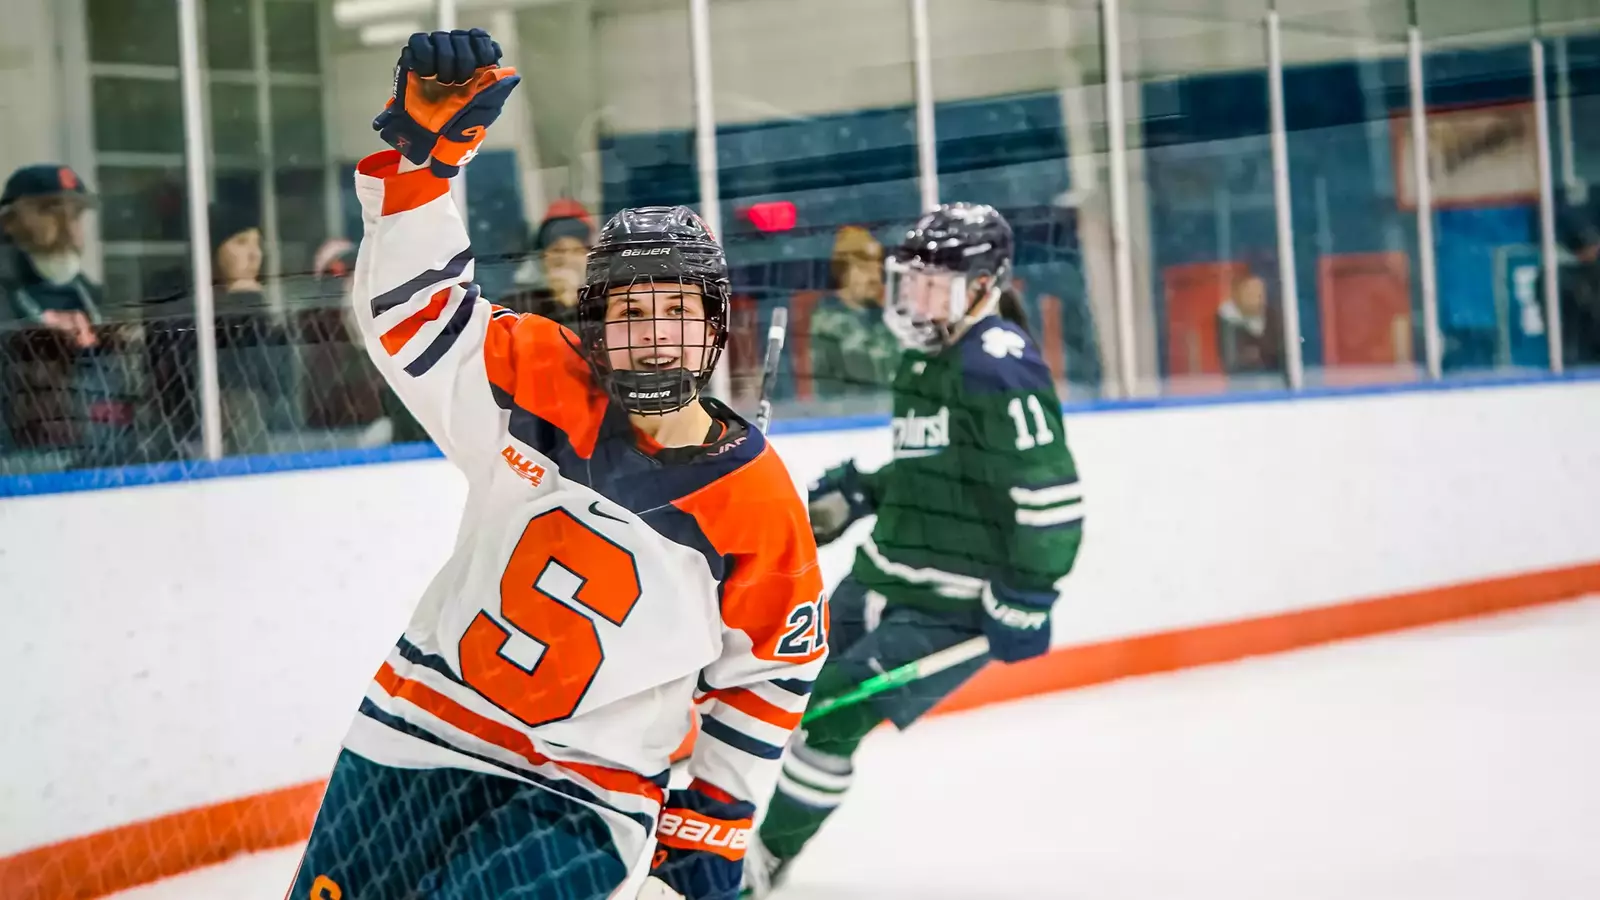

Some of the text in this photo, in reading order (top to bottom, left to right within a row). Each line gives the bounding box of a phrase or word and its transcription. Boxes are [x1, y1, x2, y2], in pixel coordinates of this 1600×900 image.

[621, 247, 671, 257] BAUER
[628, 390, 671, 399] BAUER
[1007, 394, 1054, 451] 11
[458, 506, 643, 728] S
[773, 590, 826, 656] 21
[657, 812, 751, 850] BAUE
